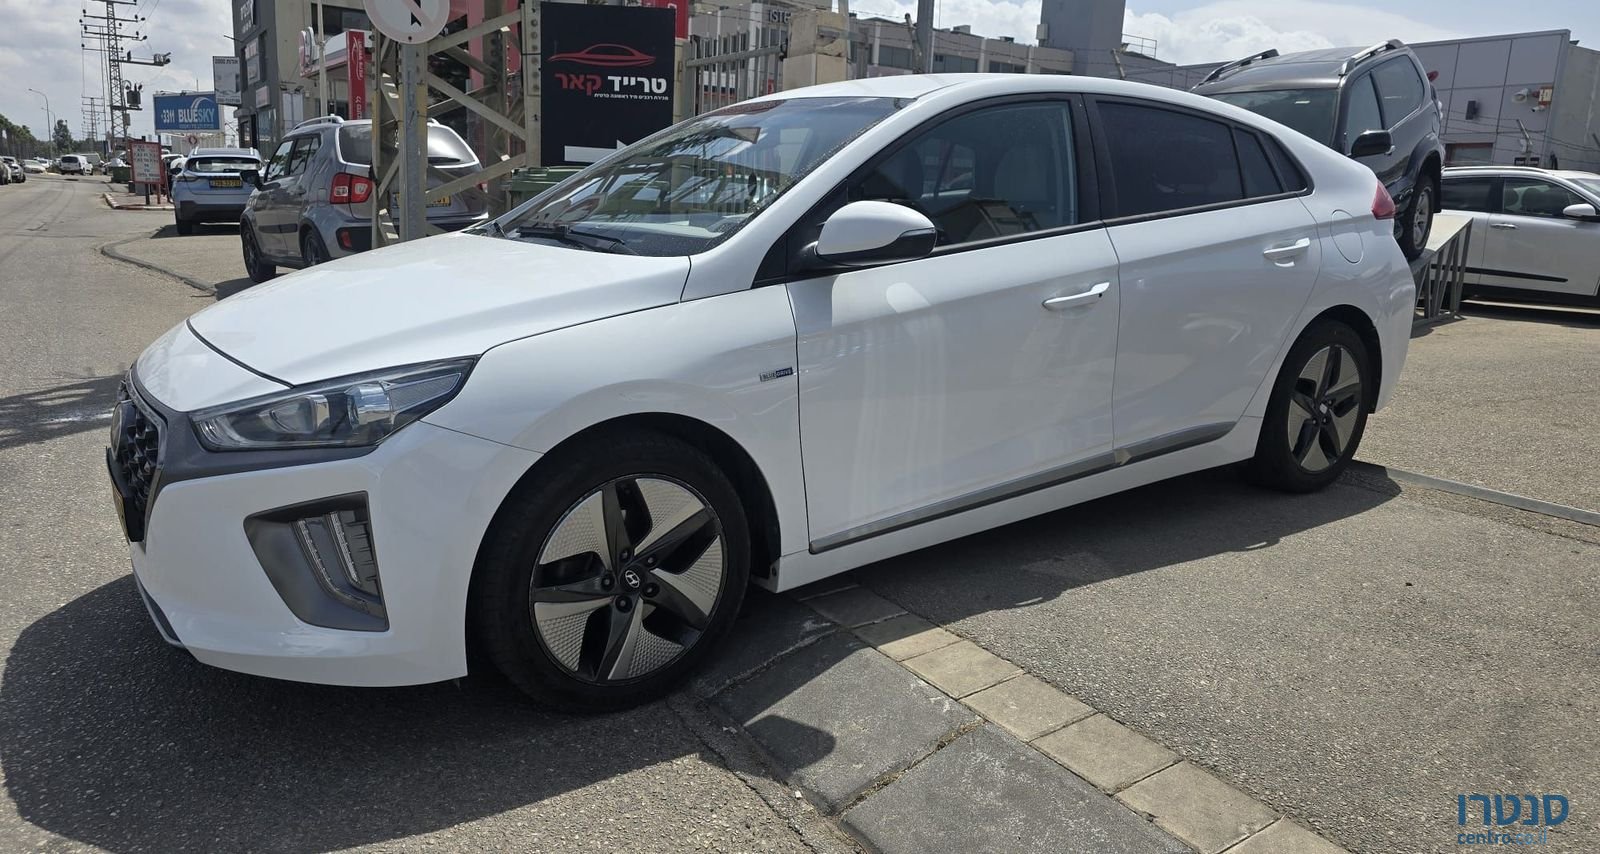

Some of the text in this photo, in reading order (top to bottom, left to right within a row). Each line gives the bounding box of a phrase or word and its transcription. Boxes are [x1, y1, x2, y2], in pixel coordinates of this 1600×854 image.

[554, 72, 667, 97] טרייד קאר
[178, 108, 215, 123] BLUESKY
